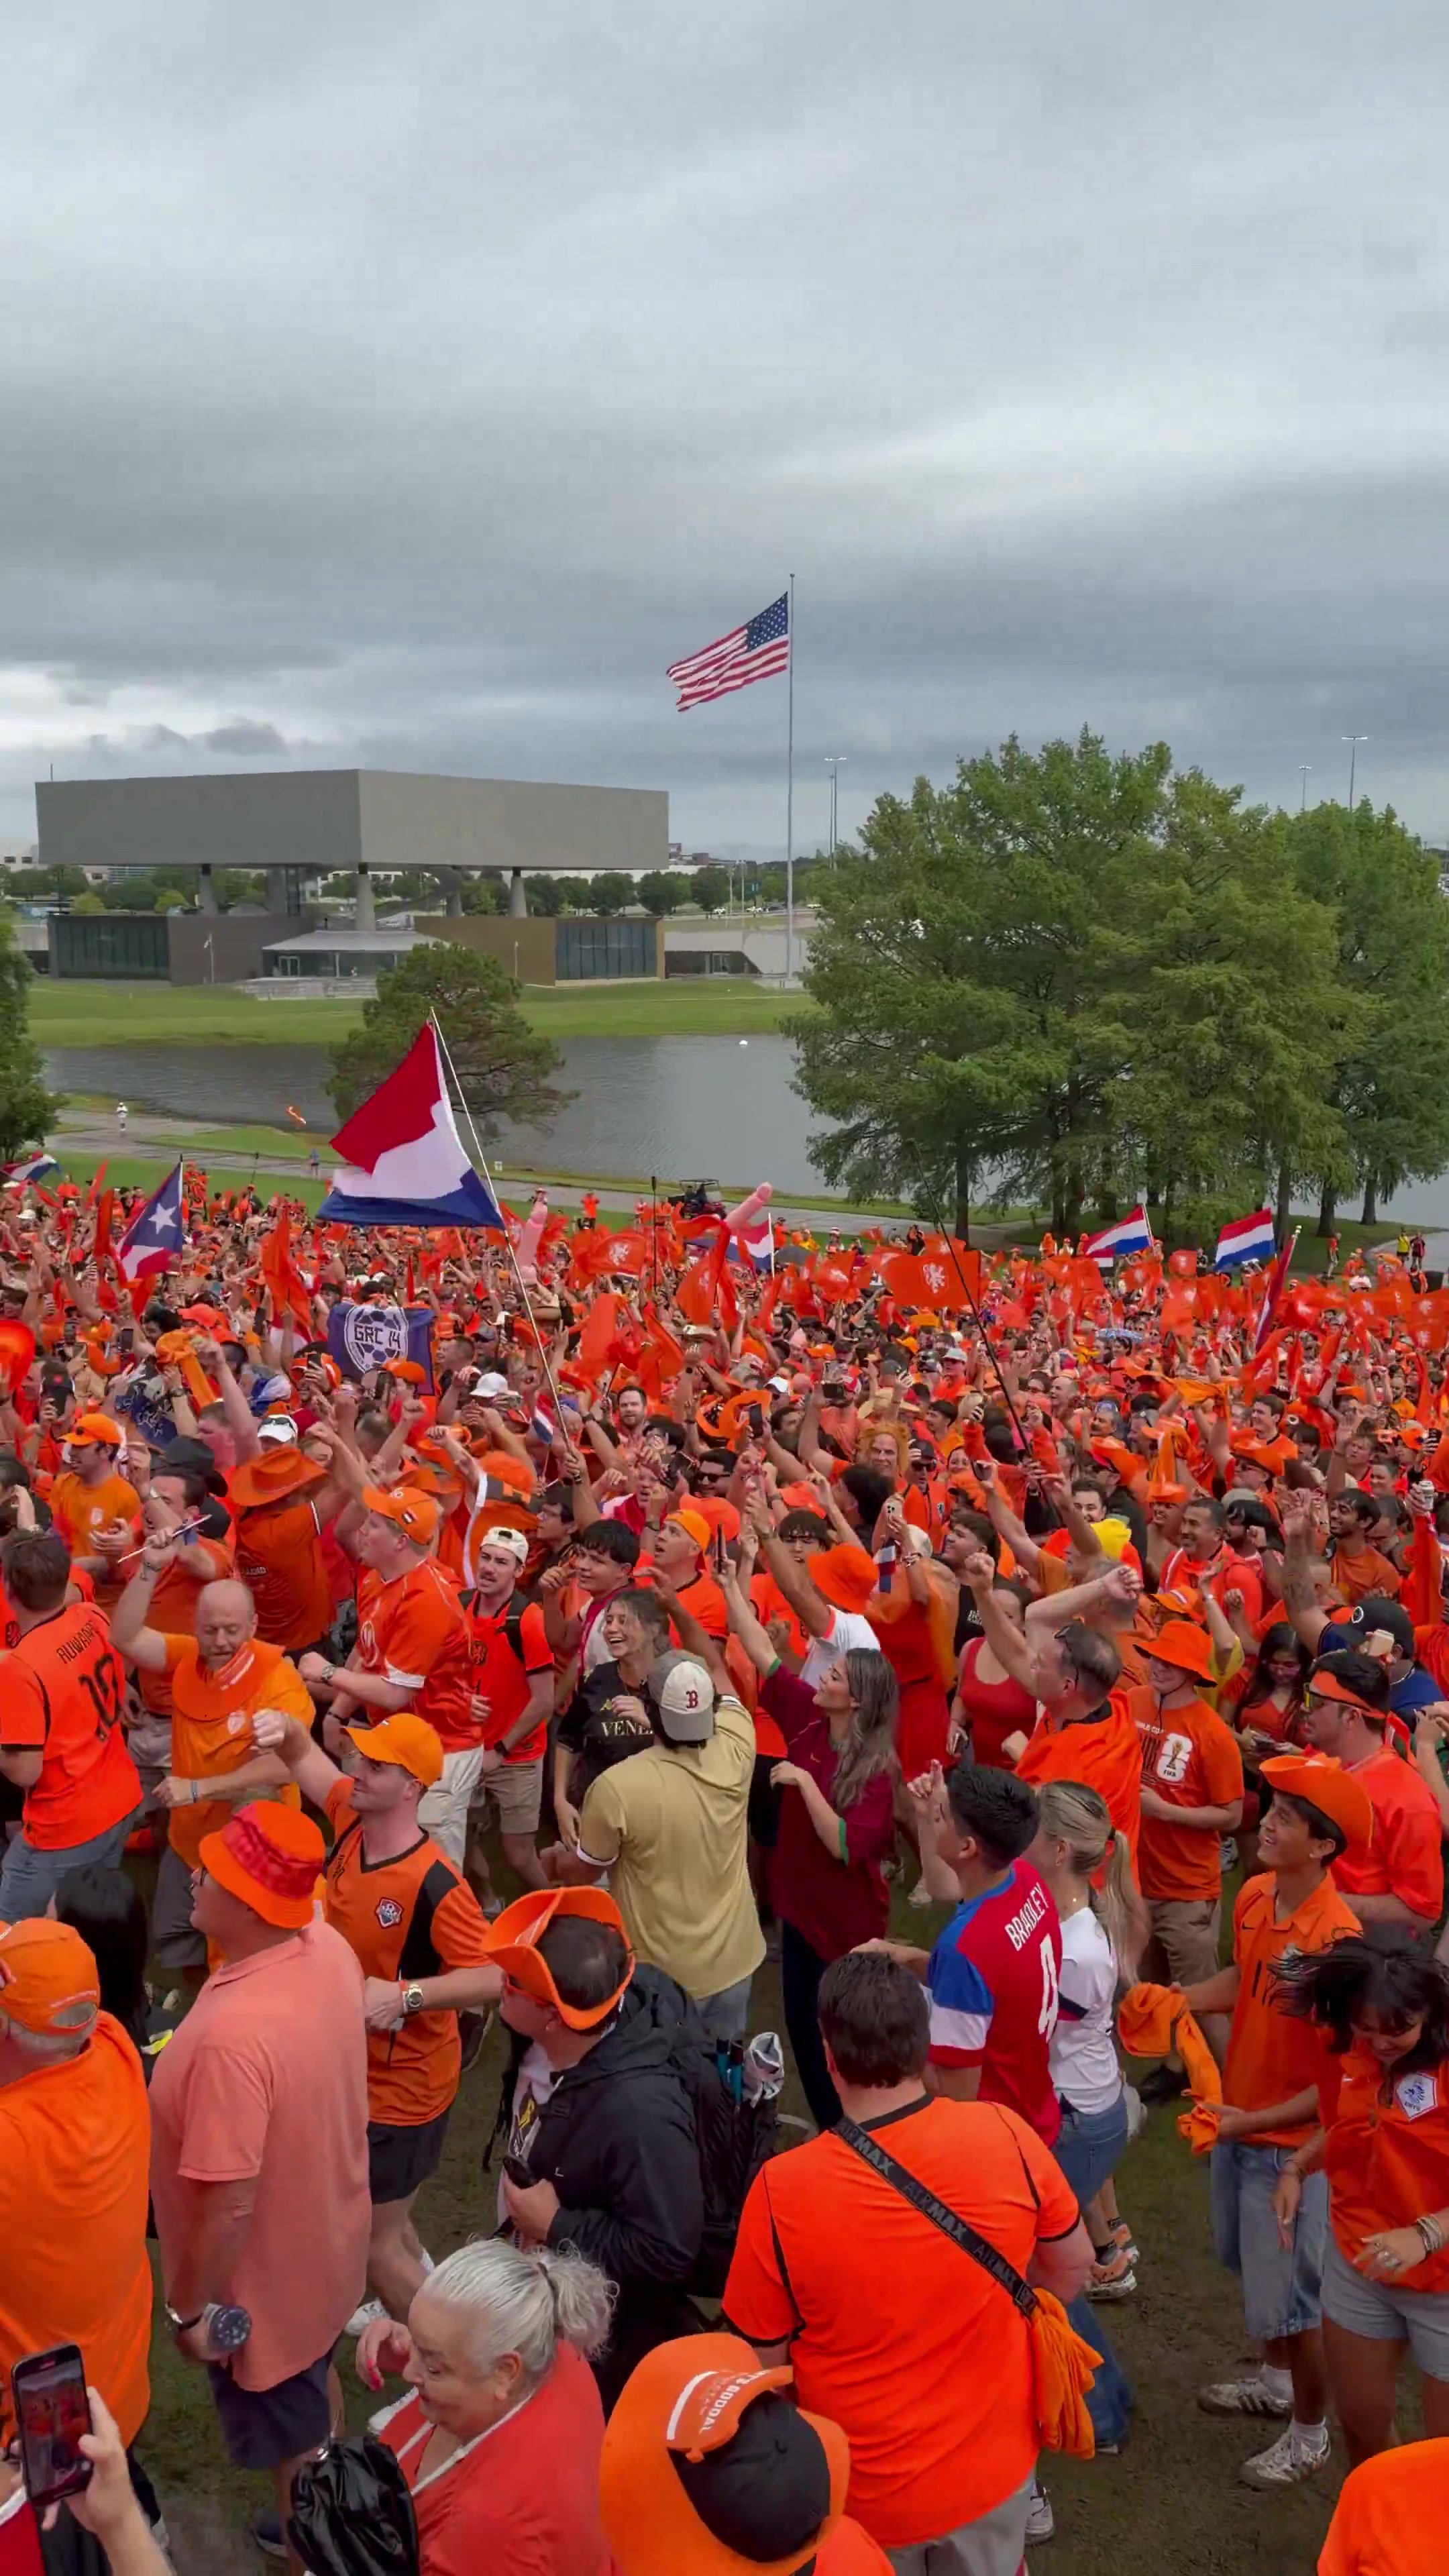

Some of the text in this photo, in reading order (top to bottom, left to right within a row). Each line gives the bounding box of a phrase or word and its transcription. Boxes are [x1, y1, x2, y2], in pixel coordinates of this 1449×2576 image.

[354, 1324, 401, 1349] GRC 14
[686, 1689, 698, 1709] B
[1005, 1882, 1049, 1951] BRADLEY
[1038, 1933, 1059, 2043] 4
